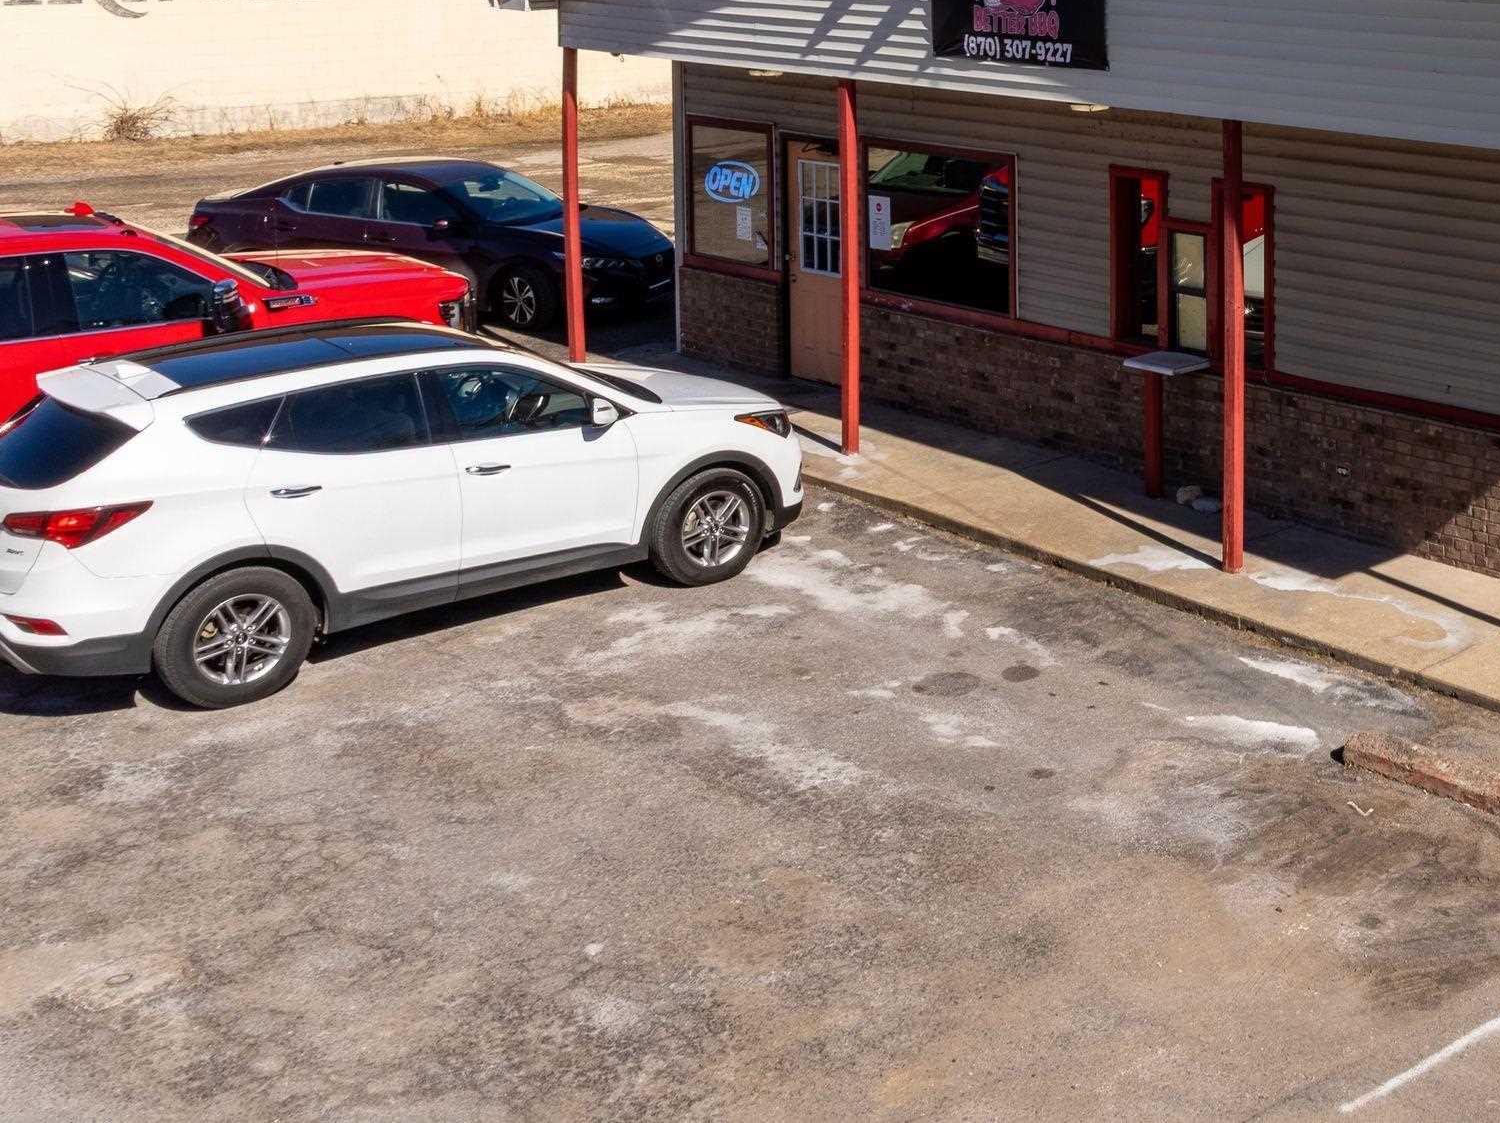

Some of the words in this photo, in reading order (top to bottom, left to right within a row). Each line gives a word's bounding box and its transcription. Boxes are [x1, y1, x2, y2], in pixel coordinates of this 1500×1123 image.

[973, 5, 1026, 35] BETTER
[1027, 10, 1060, 40] BBQ
[963, 34, 1001, 59] (870)
[1003, 38, 1073, 64] 307-9227
[709, 165, 754, 199] OPEN
